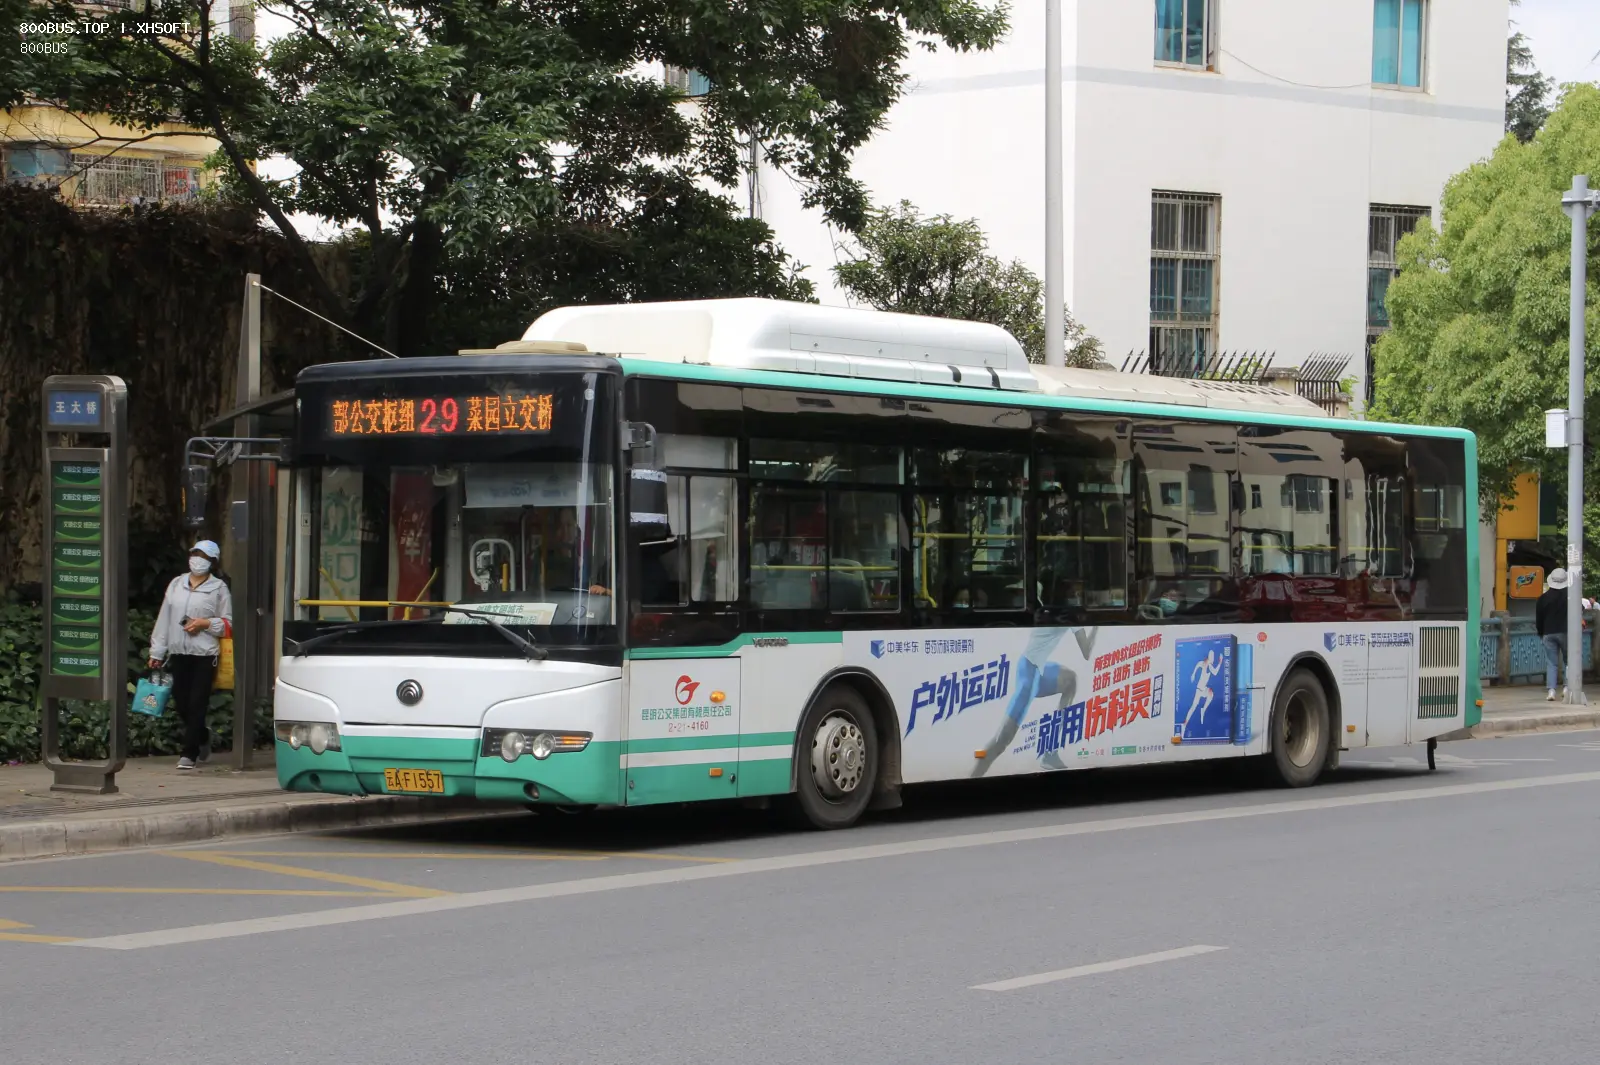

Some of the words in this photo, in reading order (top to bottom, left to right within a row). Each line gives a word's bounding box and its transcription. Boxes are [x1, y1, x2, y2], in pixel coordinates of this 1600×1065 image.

[55, 401, 97, 415] 王大桥
[332, 399, 415, 434] 部公交枢纽
[419, 398, 460, 433] 29
[466, 394, 553, 432] 菜园立交桥
[887, 641, 919, 653] 中美华东
[1338, 633, 1366, 647] 中美华东
[1092, 671, 1111, 692] 拉伤
[904, 653, 1010, 741] 户外运动
[641, 705, 732, 721] 昆明公交集团有限责任公司
